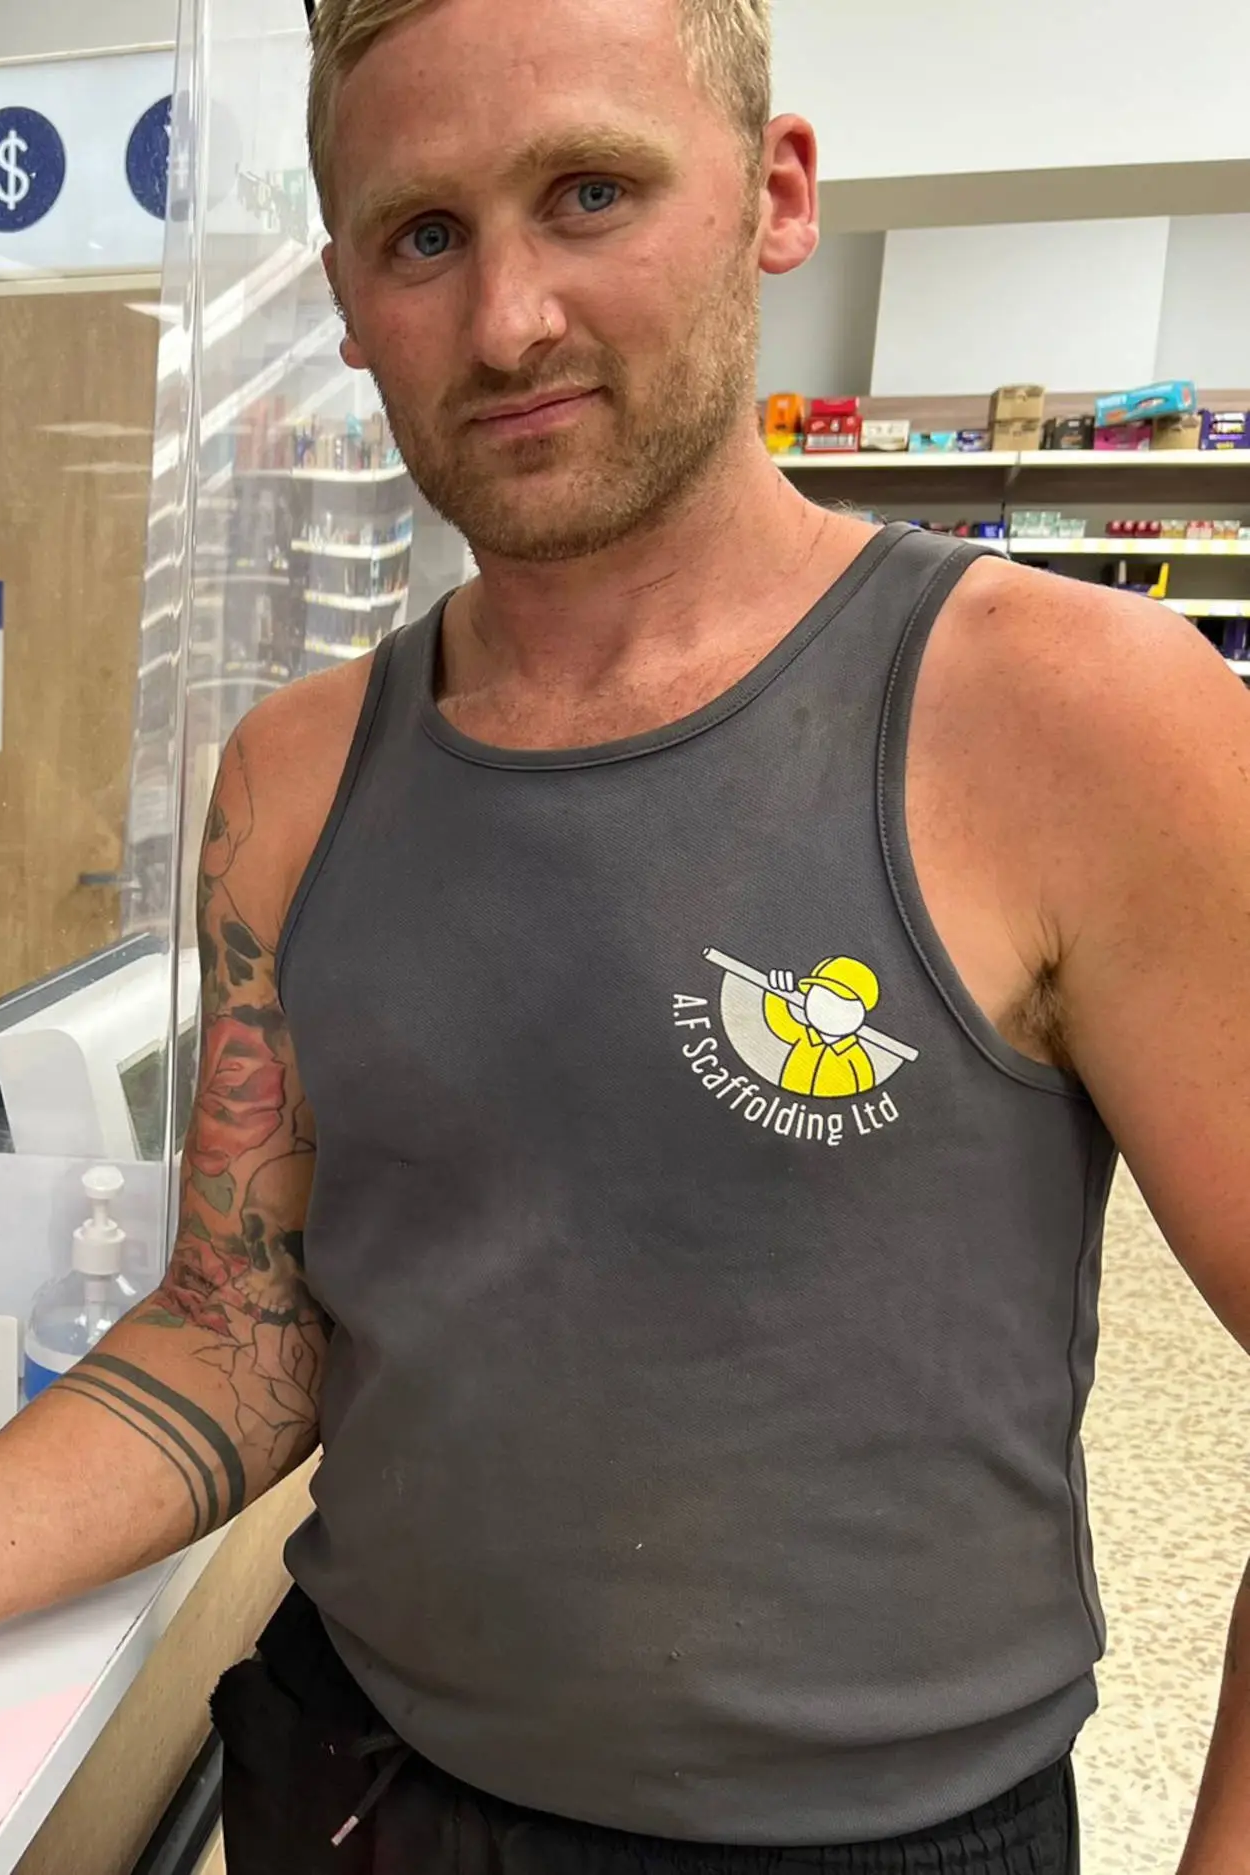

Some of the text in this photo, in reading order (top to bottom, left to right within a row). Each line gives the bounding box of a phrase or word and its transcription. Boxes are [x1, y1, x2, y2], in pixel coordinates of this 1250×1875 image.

[672, 993, 899, 1146] A.F Scaffolding Ltd
